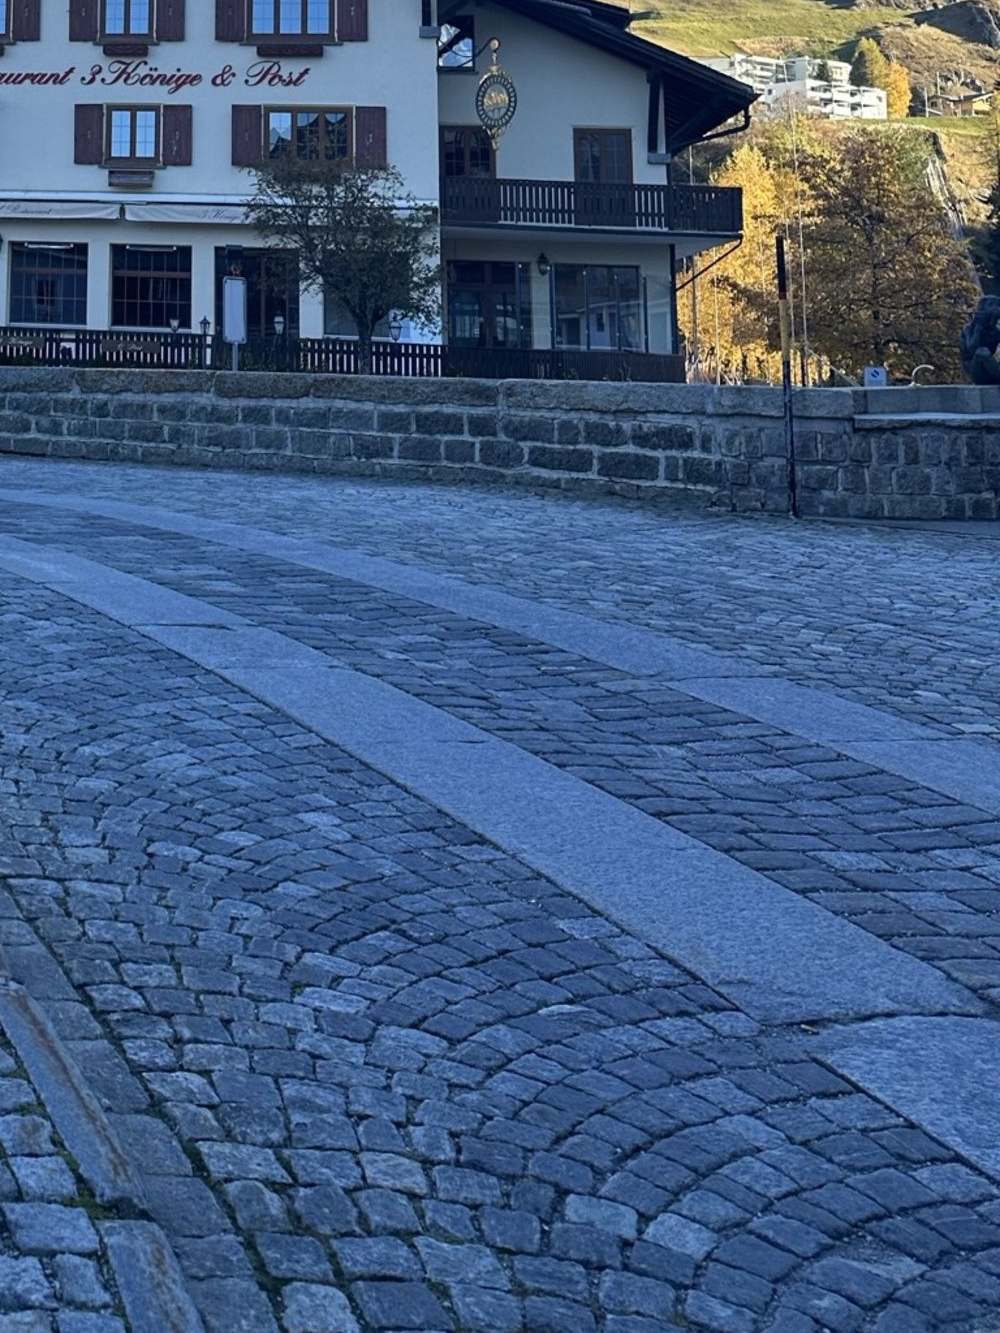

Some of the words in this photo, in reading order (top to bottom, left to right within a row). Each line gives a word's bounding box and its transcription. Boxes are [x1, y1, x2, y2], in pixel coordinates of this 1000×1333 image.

[80, 64, 103, 86] 3
[101, 60, 203, 95] Könige
[211, 64, 237, 87] &
[244, 60, 311, 87] Post
